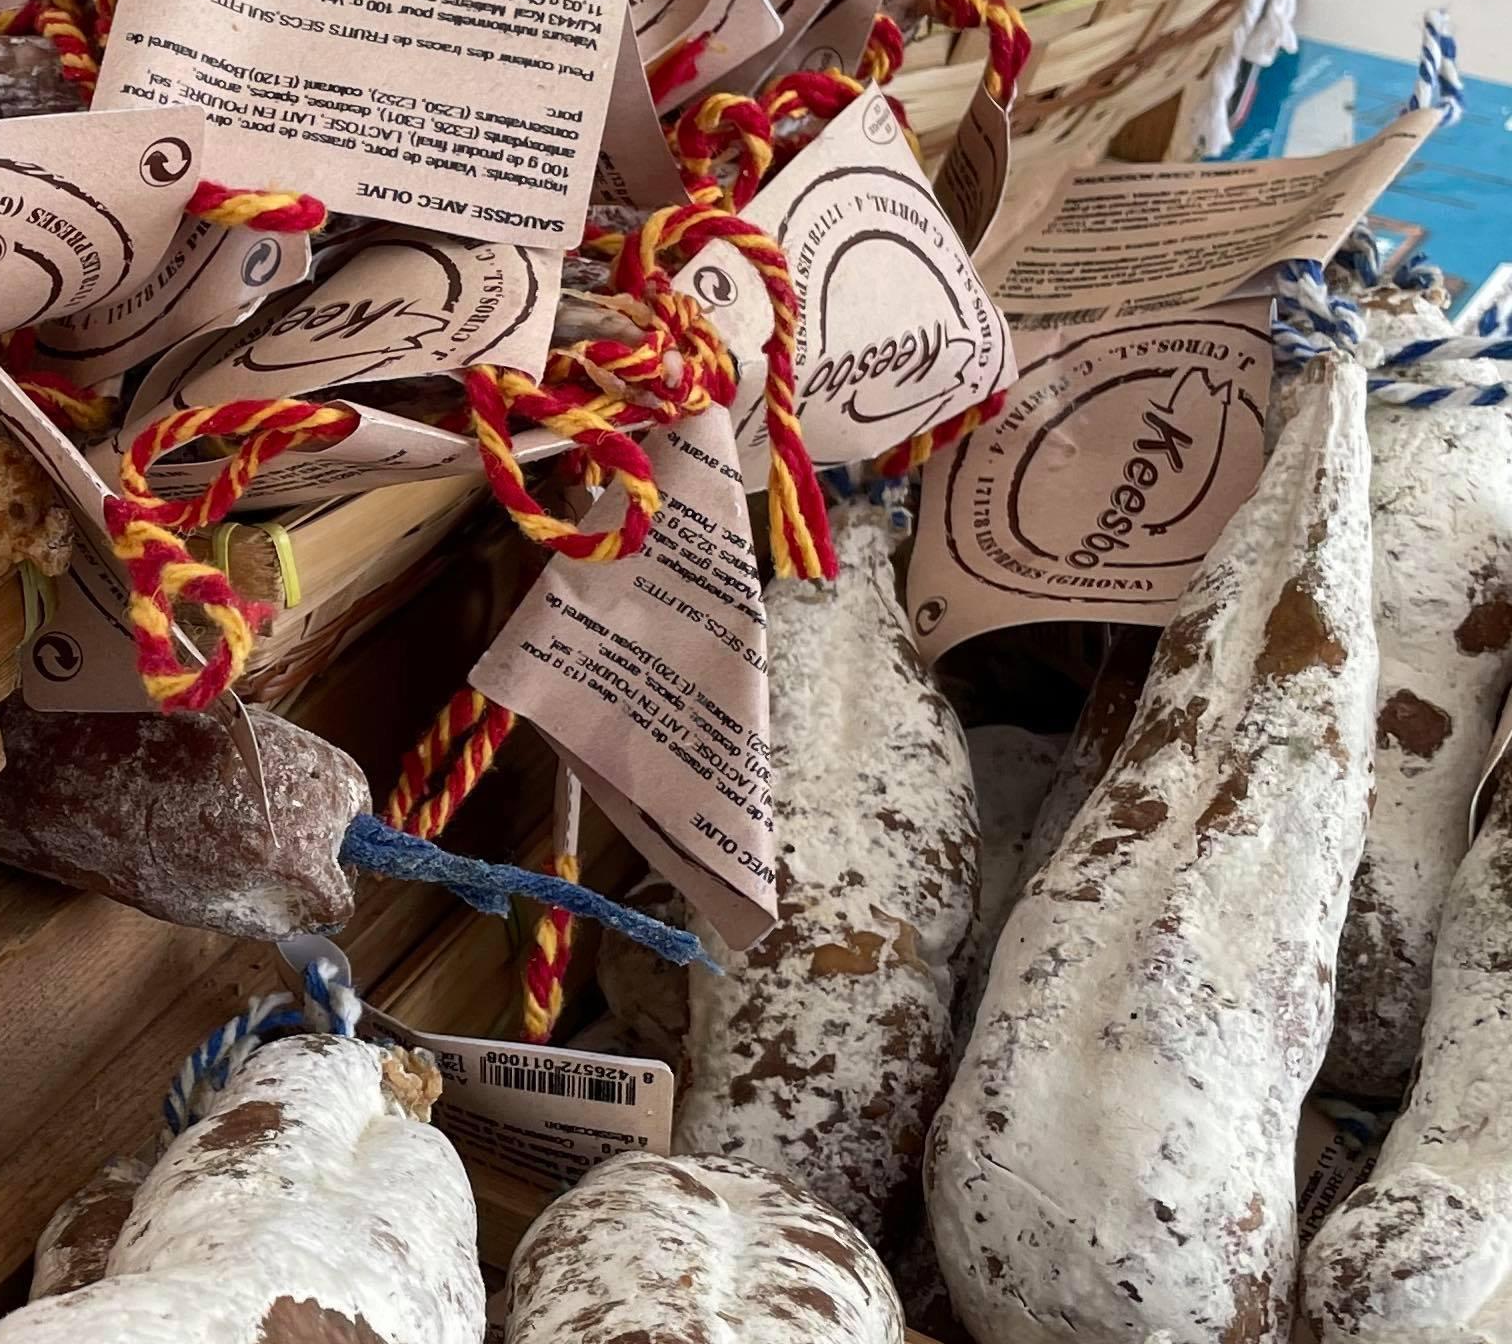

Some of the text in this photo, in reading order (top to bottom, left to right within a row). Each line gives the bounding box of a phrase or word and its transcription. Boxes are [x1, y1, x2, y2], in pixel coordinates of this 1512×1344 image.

[365, 0, 392, 14] 100
[397, 5, 434, 19] pour
[436, 11, 538, 37] nutritionnelles
[513, 7, 545, 23] Kcal
[328, 23, 594, 82] Peut contenir des traces de FRUITS
[541, 29, 597, 51] Valeurs
[125, 32, 579, 140] conservateurs colorant naturel de
[119, 83, 477, 178] Viande de porc, graisse de porc, pour
[171, 81, 569, 178] 100 de produit LACTOSE, LAIT EN POUDRE,
[246, 84, 576, 158] antioxydants (E326, E301), dextrose, épices,
[355, 182, 565, 232] SAUCISSE AVEC OLIVE
[810, 202, 845, 244] 17178
[853, 195, 864, 213] 4
[865, 192, 930, 234] PORTAL,
[26, 206, 92, 261] PRESES
[106, 251, 187, 326] 17178 LES
[450, 269, 505, 343] CUROS,S.L.
[272, 297, 405, 342] Kee
[801, 320, 942, 402] Keesbo
[1107, 338, 1231, 362] CUROS,S.L.
[1237, 351, 1256, 373] J.
[988, 443, 1006, 456] 4
[973, 475, 996, 531] 17178
[1063, 411, 1194, 570] Keesbo
[666, 496, 717, 533] Produit
[677, 526, 717, 555] 32,29
[656, 553, 735, 604] énergétique
[678, 547, 757, 600] Acides gras
[1045, 575, 1155, 593] (GIRONA)
[544, 591, 609, 636] naturel de
[519, 640, 718, 780] graisse olive pour
[644, 671, 687, 711] épices,
[576, 650, 762, 794] LACTOSE, LAIT EN POUDRE,
[689, 812, 738, 854] OLIVE
[484, 1050, 654, 1084] 8 426572 011008
